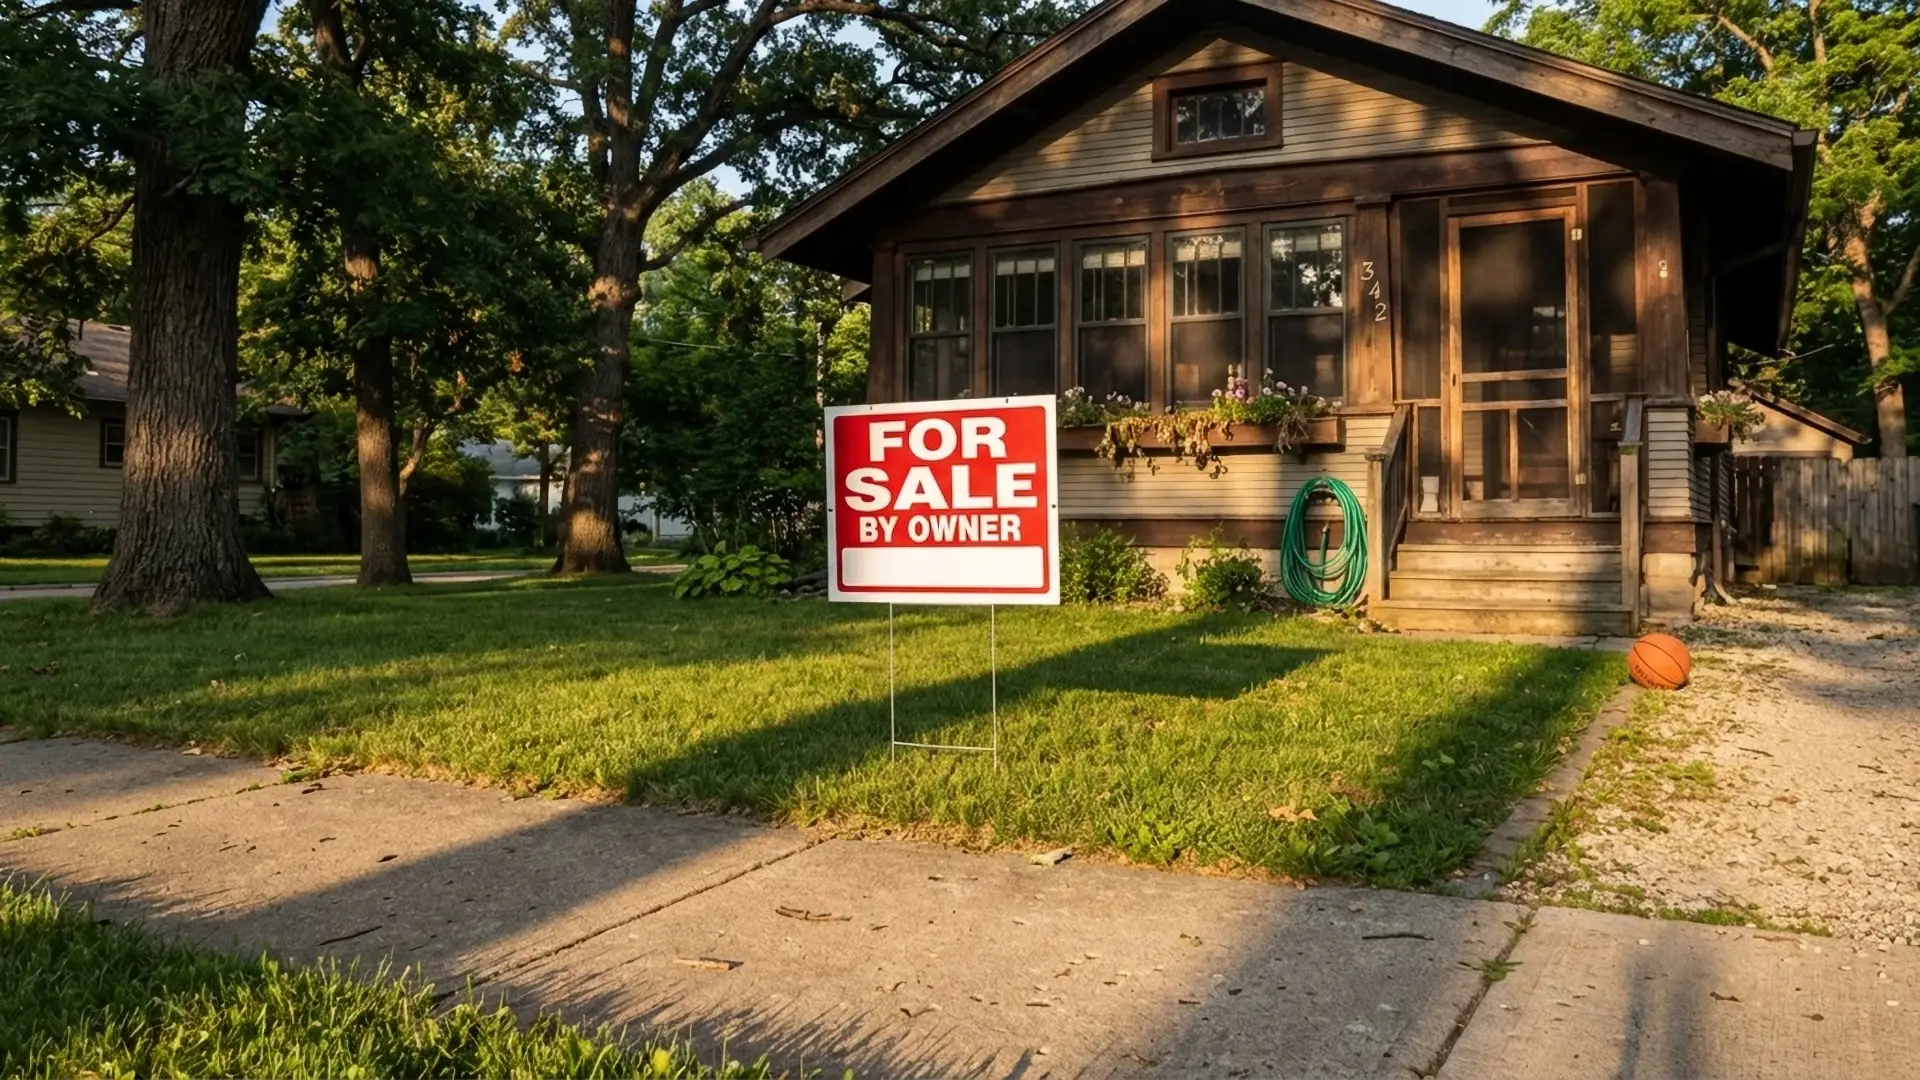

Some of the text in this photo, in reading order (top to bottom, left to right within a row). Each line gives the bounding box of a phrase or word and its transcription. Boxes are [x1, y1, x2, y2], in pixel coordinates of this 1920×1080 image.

[1360, 261, 1387, 322] 342
[869, 416, 1007, 462] FOR
[845, 463, 1038, 512] SALE
[859, 514, 1022, 543] BY OWNER
